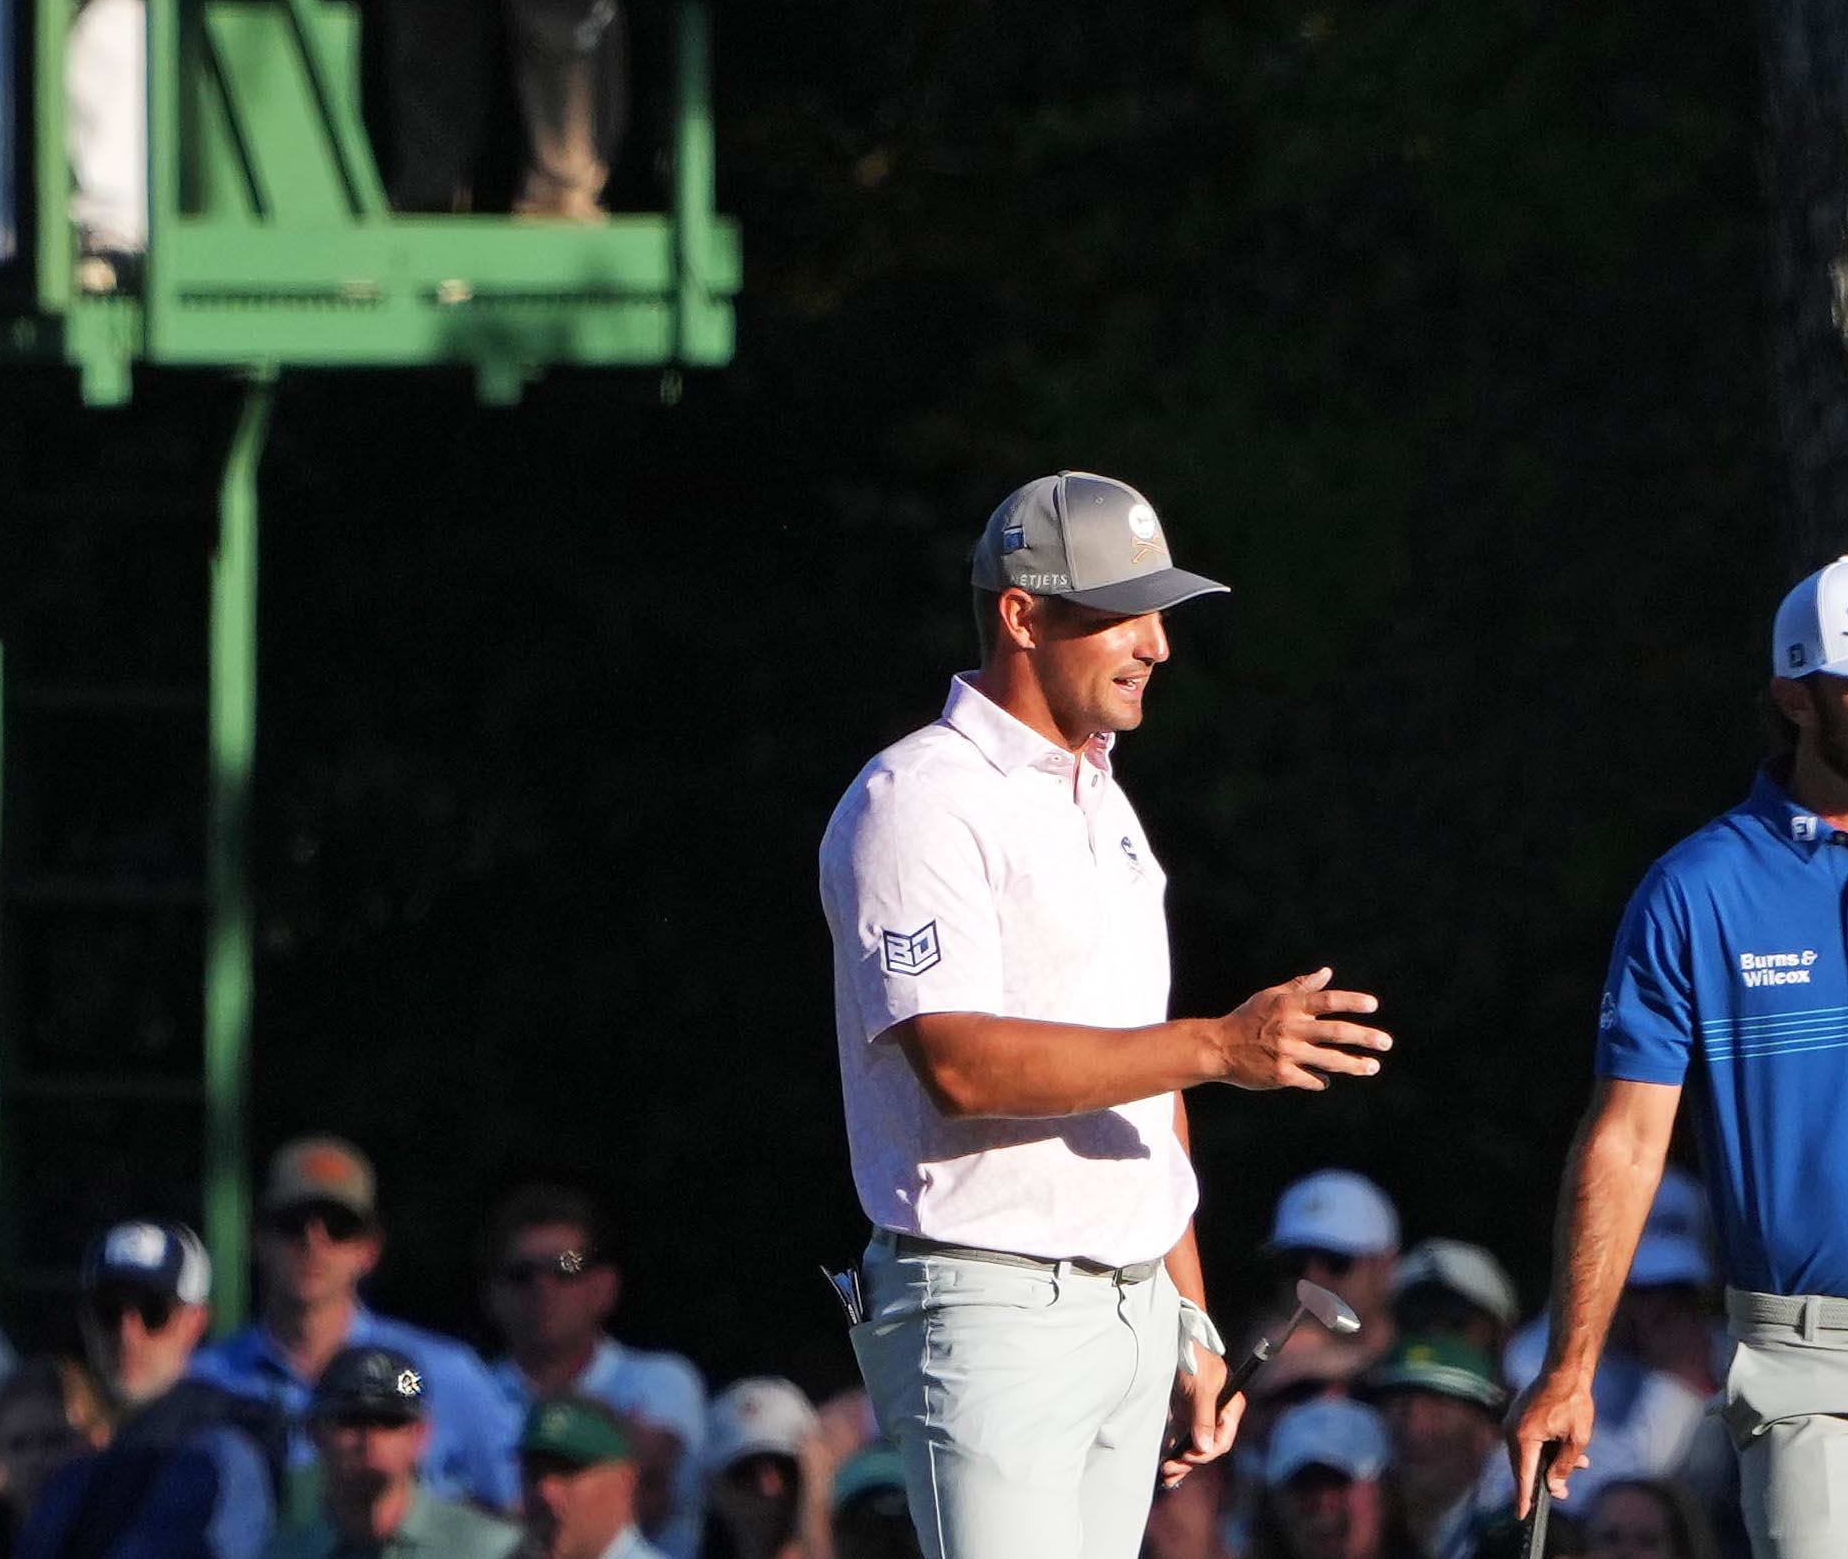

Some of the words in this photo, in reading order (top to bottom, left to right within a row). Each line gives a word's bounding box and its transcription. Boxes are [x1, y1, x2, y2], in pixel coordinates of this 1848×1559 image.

[1740, 953, 1800, 970] Burns
[1800, 950, 1818, 966] &
[1742, 969, 1811, 987] Wilcox
